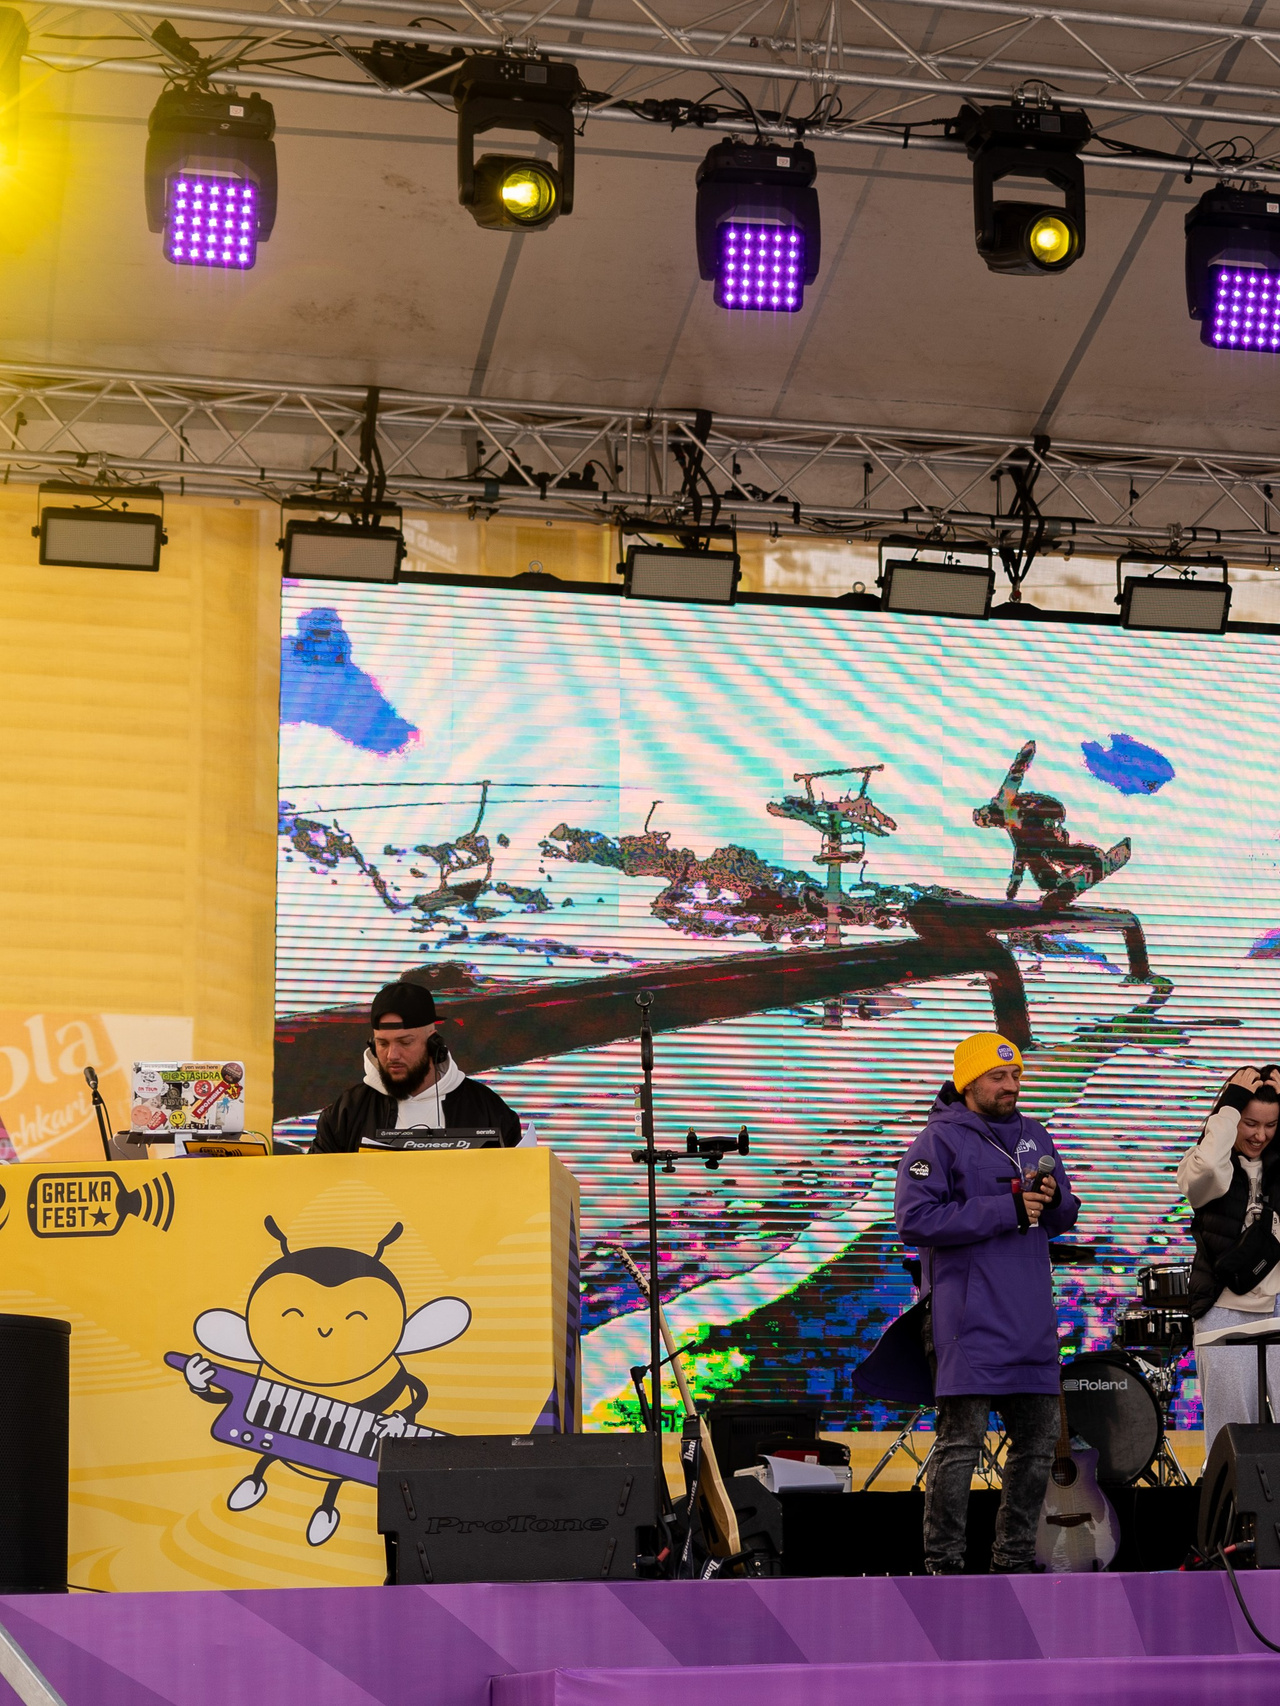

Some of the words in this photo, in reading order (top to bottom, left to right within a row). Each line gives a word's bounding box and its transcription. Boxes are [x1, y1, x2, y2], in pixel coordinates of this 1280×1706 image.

[403, 1140, 454, 1149] Pioneer
[42, 1181, 112, 1204] GRELKA
[42, 1206, 89, 1228] FEST
[1079, 1379, 1128, 1391] Roland
[425, 1515, 608, 1535] ProTone
